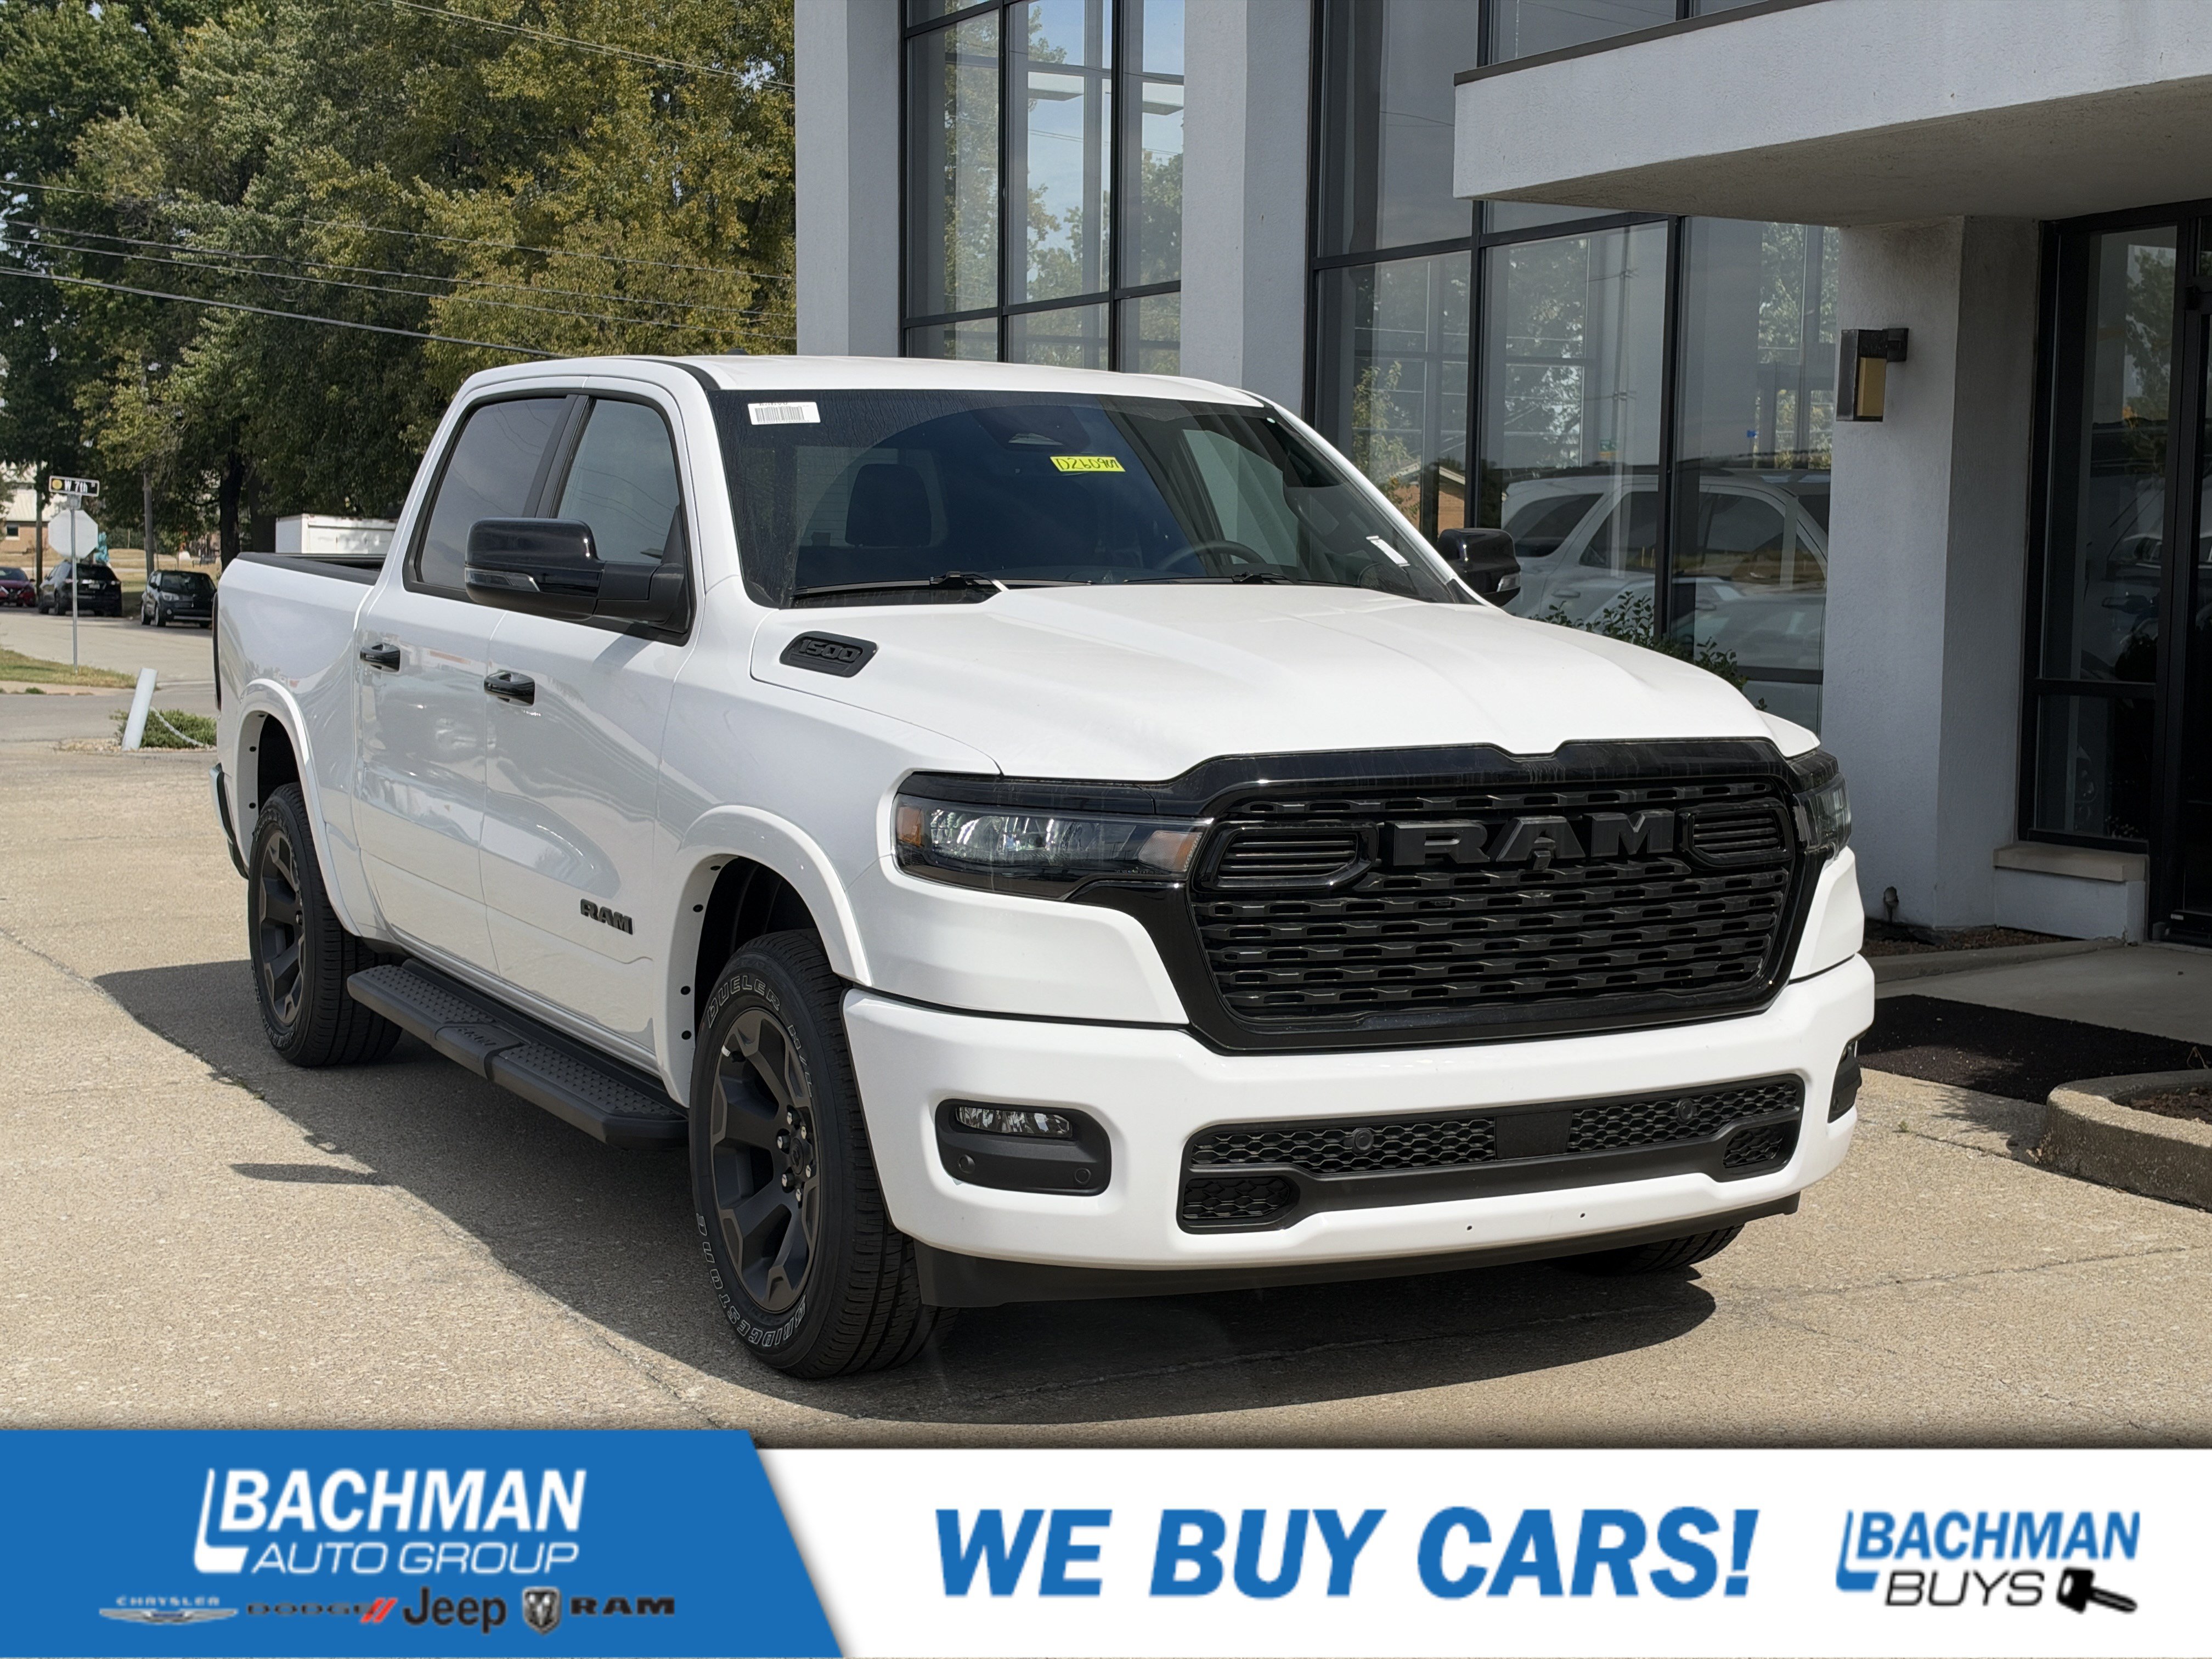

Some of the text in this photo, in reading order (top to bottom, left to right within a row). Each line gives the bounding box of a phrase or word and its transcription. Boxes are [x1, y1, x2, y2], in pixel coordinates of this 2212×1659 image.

[64, 479, 72, 492] W
[75, 481, 88, 493] 7th
[799, 639, 861, 664] 1500
[1392, 809, 1675, 867] RAM
[580, 898, 633, 935] RAM
[707, 975, 780, 1029] DUELER
[696, 1212, 806, 1347] BRIDGESTONE
